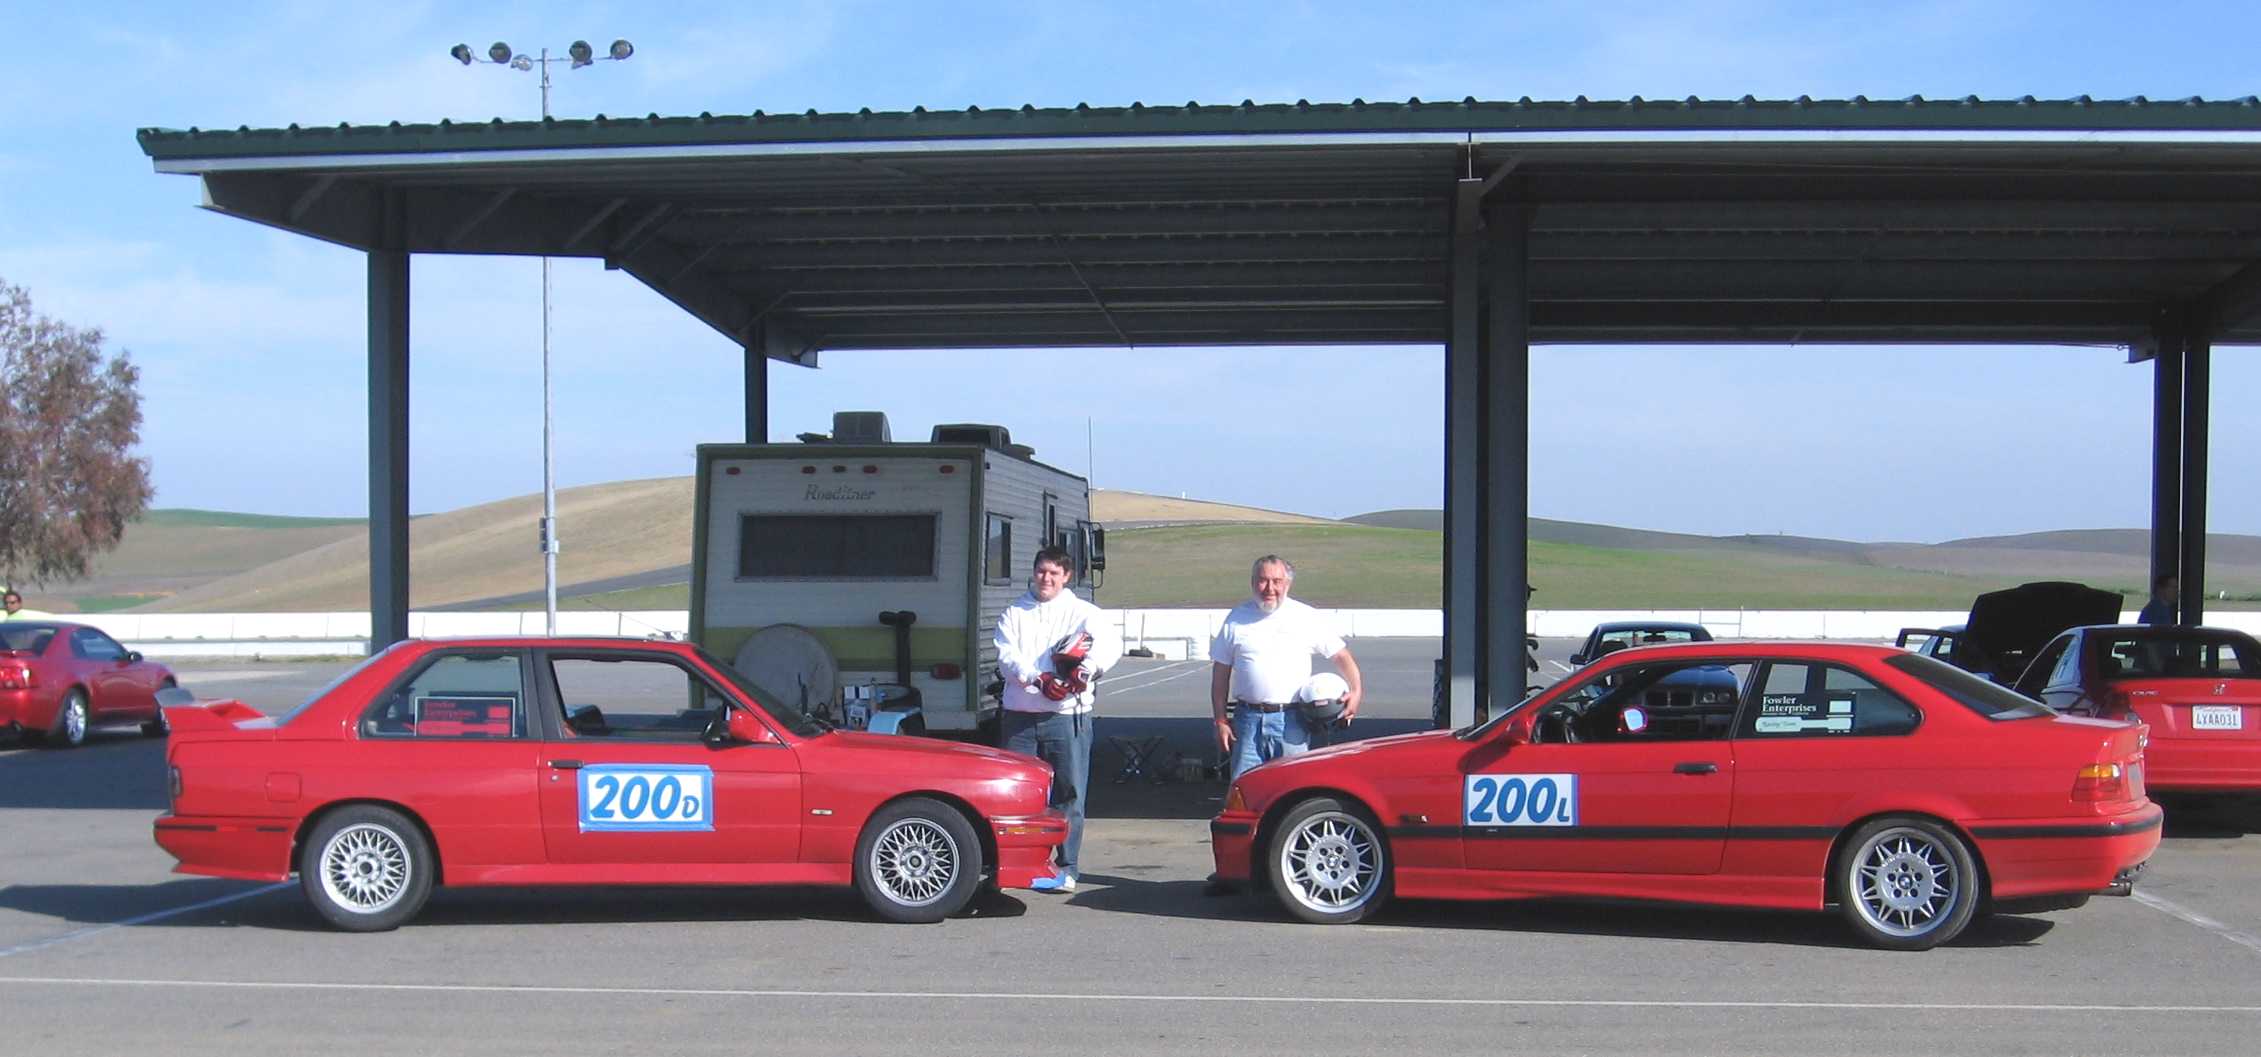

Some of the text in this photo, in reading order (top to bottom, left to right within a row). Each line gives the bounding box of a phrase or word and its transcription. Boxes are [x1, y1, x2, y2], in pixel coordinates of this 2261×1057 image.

[1762, 704, 1817, 714] Enterprises
[1763, 695, 1796, 705] Fowler
[590, 775, 700, 819] 200D
[1470, 777, 1570, 823] 200L
